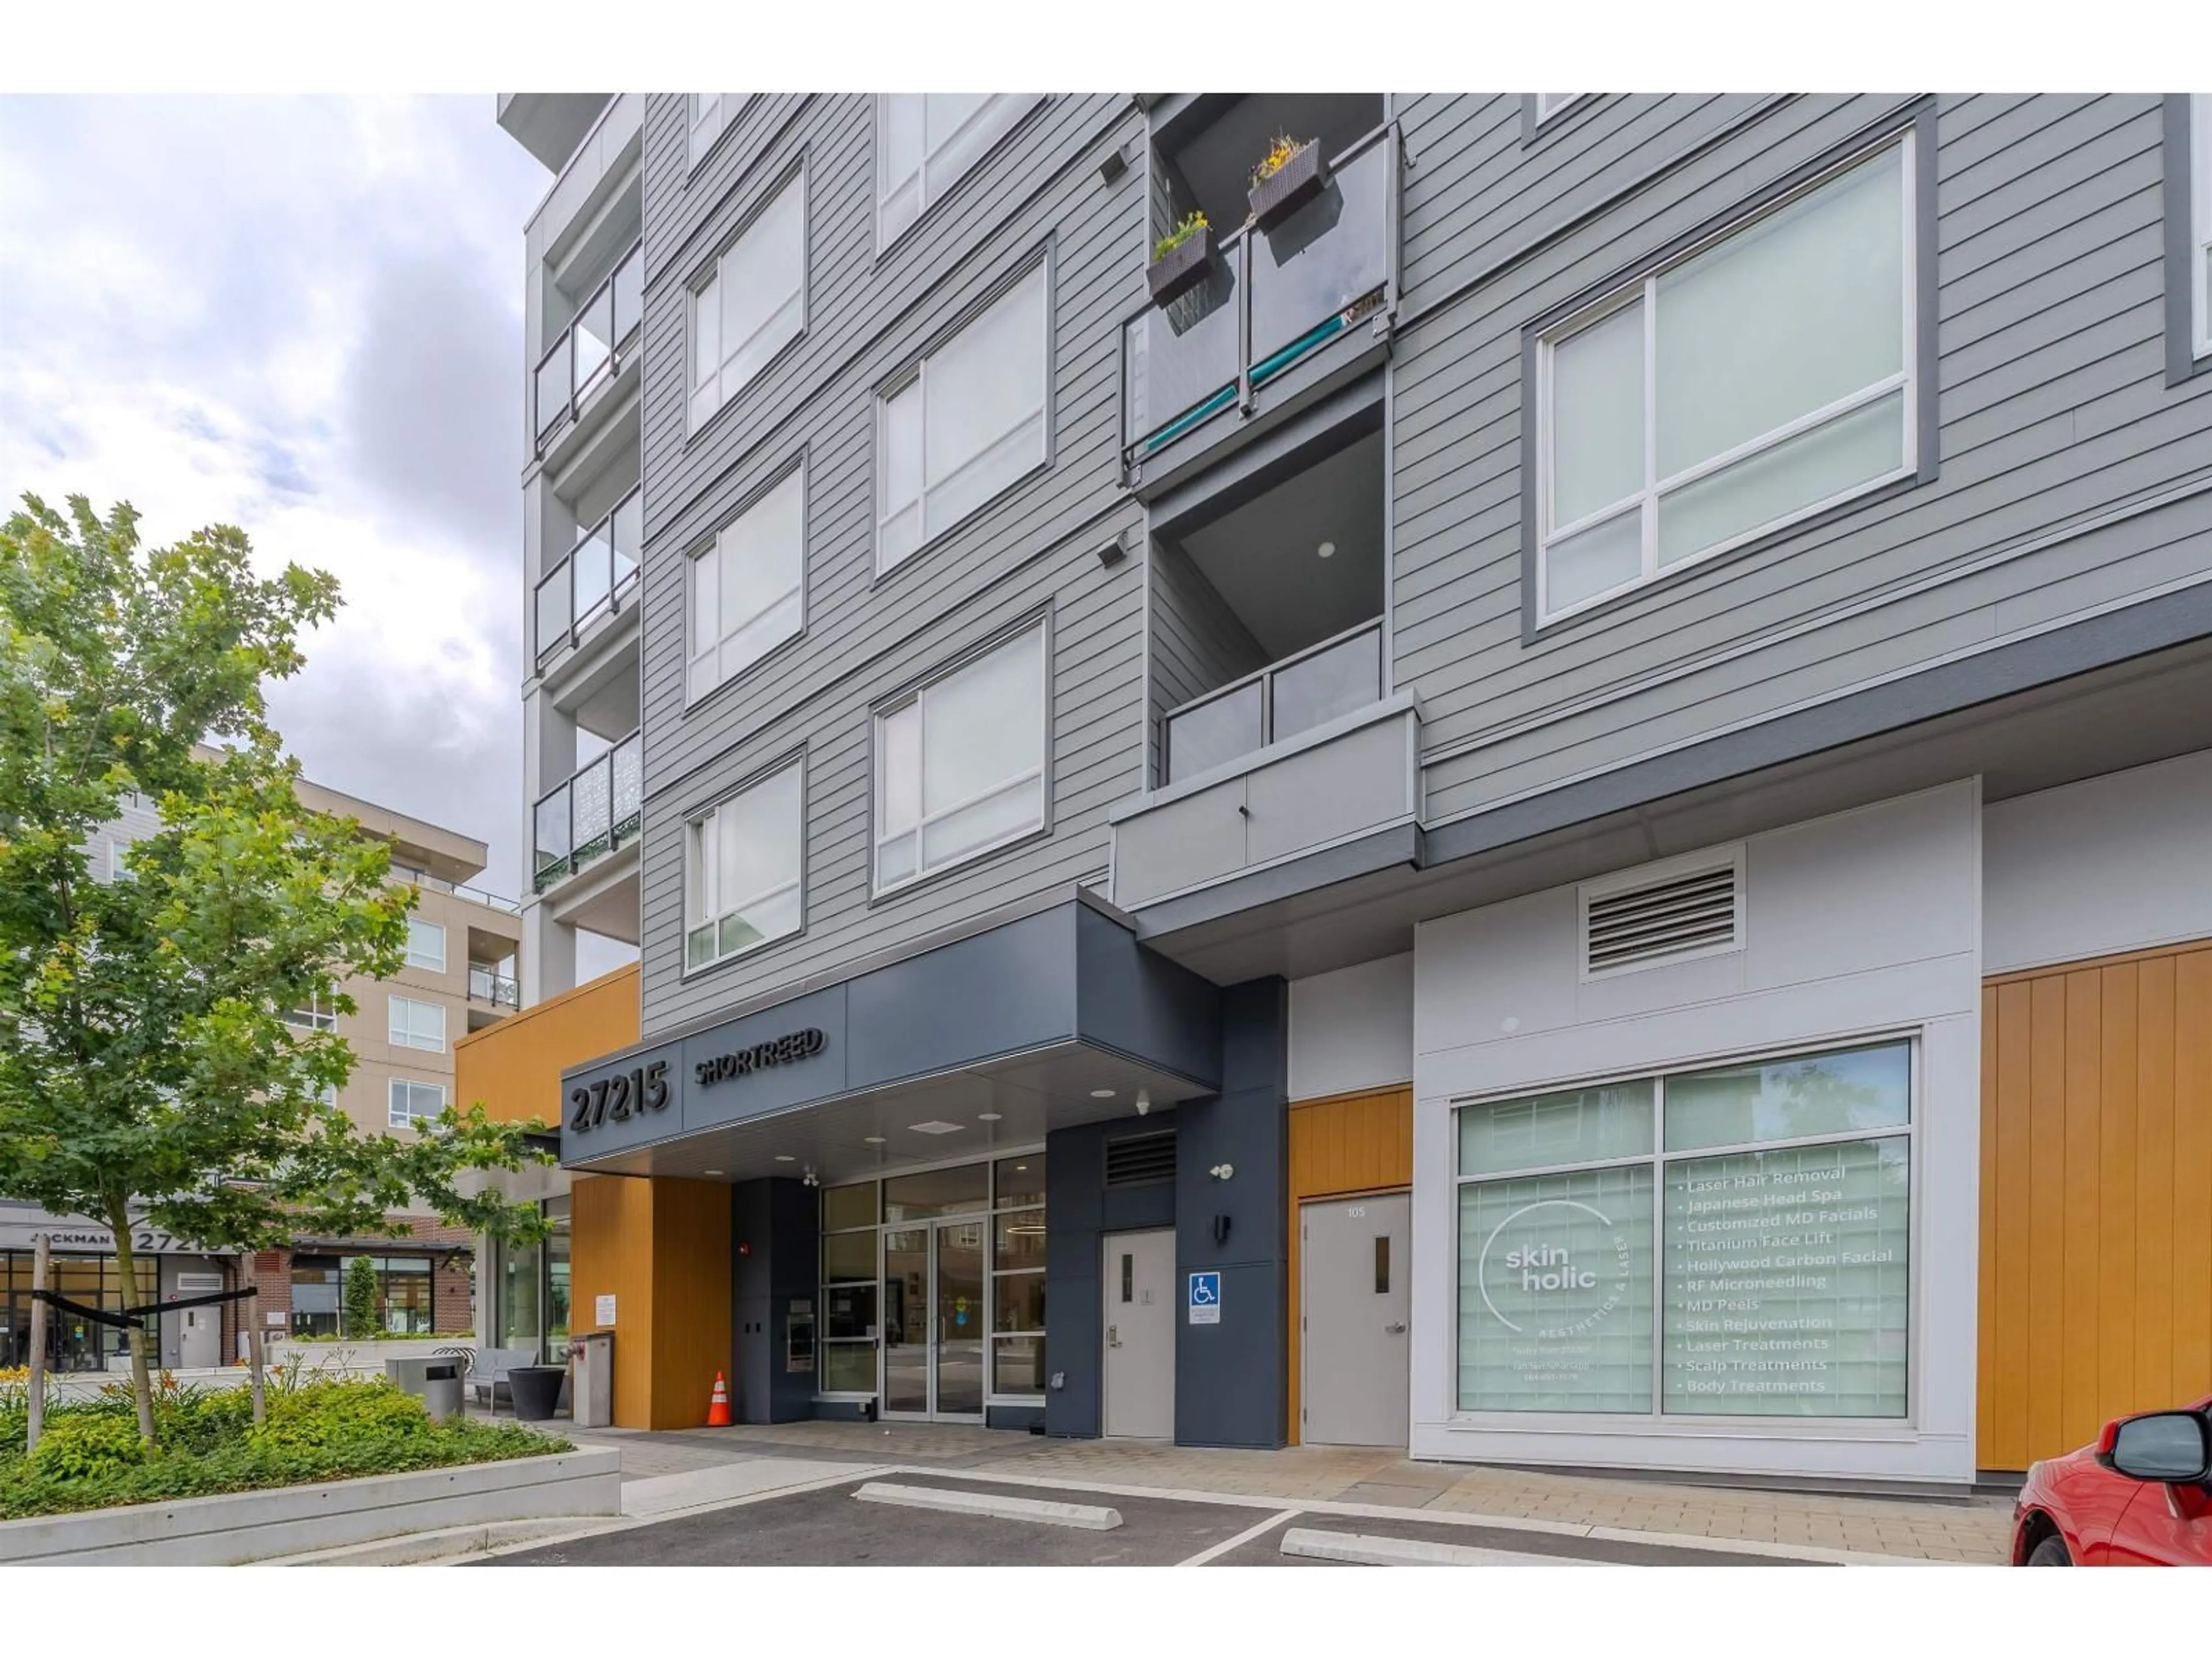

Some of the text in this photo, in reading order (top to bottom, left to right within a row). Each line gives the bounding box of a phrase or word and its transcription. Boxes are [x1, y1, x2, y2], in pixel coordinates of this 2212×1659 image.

[570, 1027, 827, 1131] 27215 SHORTREED
[1688, 1166, 1845, 1193] Laser Hair Removal
[1349, 1206, 1365, 1217] 105
[1687, 1190, 1843, 1214] Japanese Head Spa
[1688, 1207, 1878, 1232] Customized MD Facials
[1688, 1232, 1834, 1252] Titanium Face Lift
[1505, 1243, 1569, 1269] skin
[1688, 1249, 1892, 1274] Hollywood Carbon Facial
[1522, 1266, 1597, 1291] holic
[1688, 1275, 1827, 1292] RF Microneedling
[1688, 1298, 1760, 1312] MD Peels
[1685, 1316, 1832, 1333] Skin Rejuvenation
[1687, 1338, 1829, 1352] Laser Treatments
[1685, 1359, 1827, 1374] Scalp Treatments
[1688, 1380, 1825, 1394] Body Treatments
